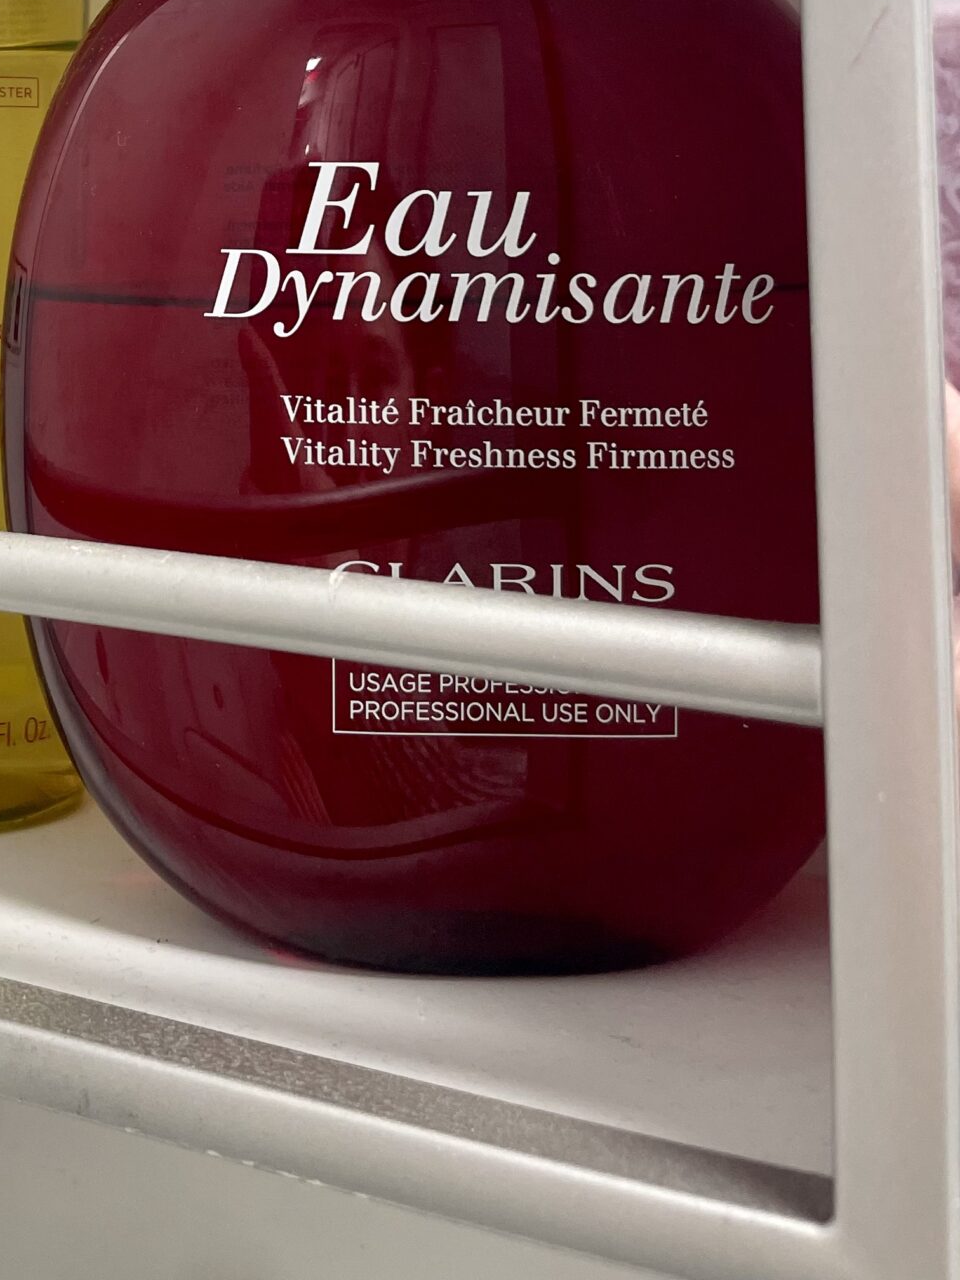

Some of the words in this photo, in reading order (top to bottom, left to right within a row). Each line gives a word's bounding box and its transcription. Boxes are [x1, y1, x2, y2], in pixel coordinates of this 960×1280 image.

[286, 161, 538, 257] Eau
[204, 249, 775, 338] Dynamisante
[280, 395, 400, 427] Vitalité
[408, 397, 571, 428] Fraîcheur
[579, 399, 709, 429] Fermeté
[281, 437, 401, 474] Vitality
[411, 439, 577, 470] Freshness
[586, 441, 736, 471] Firmness
[349, 671, 432, 694] USAGE
[349, 700, 535, 723] PROFESSIONAL
[542, 703, 588, 724] USE
[596, 704, 662, 724] ONLY
